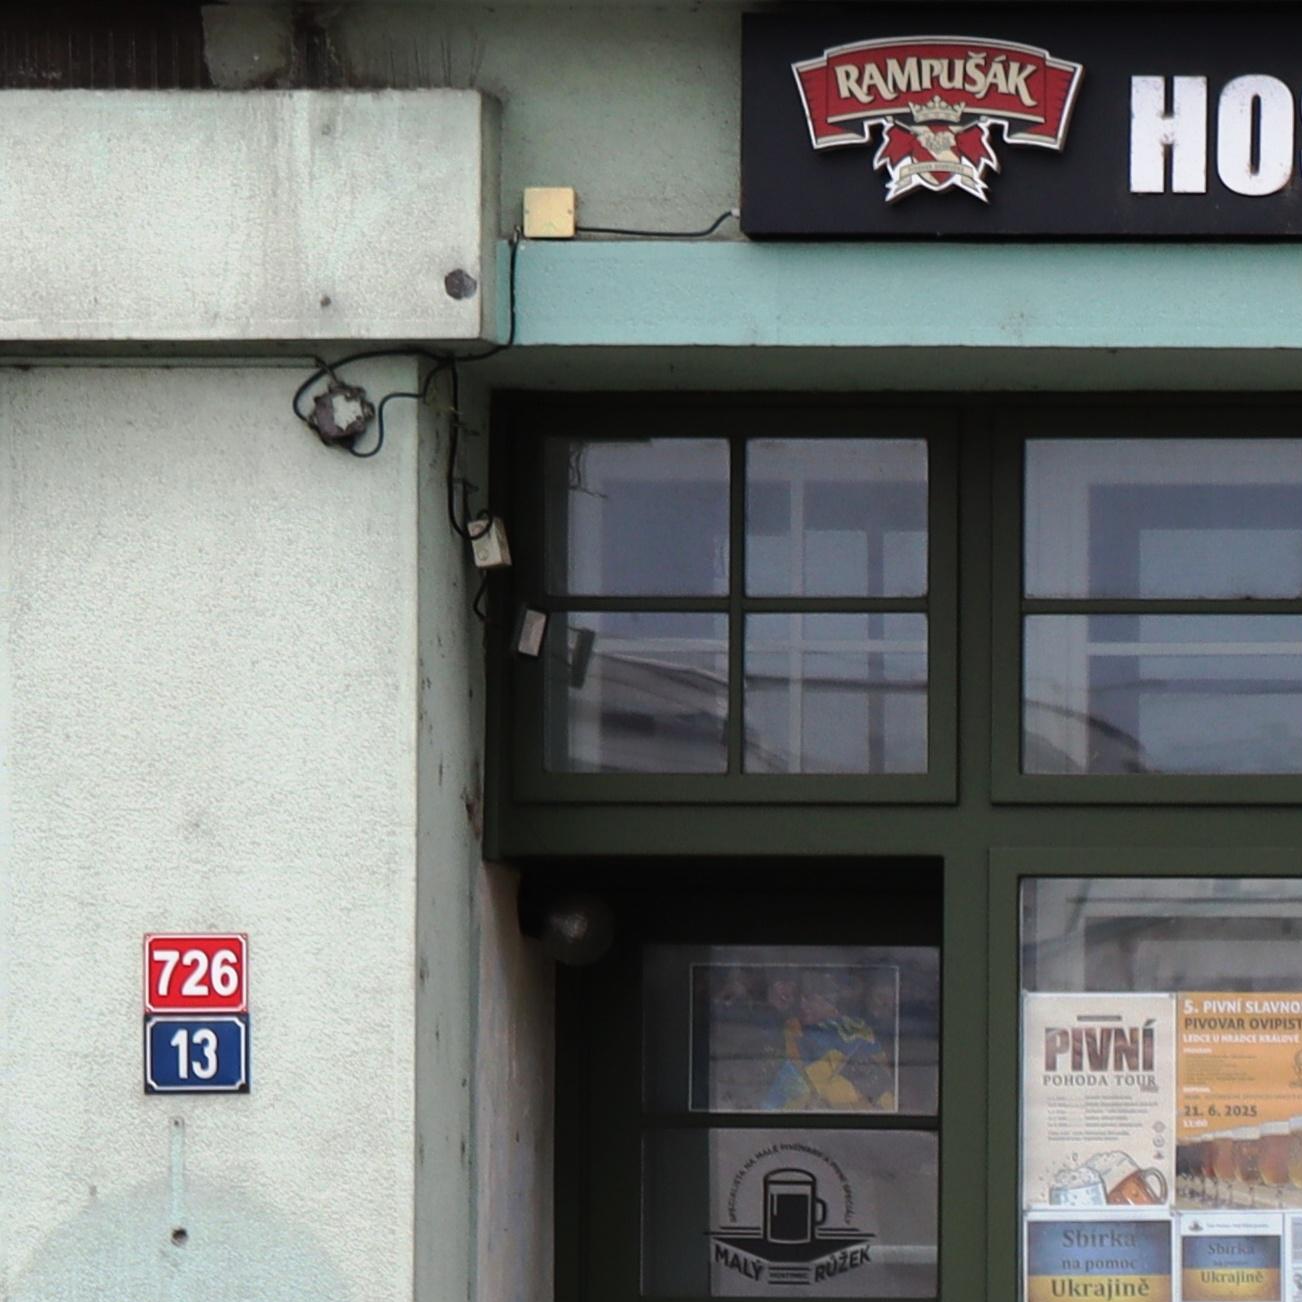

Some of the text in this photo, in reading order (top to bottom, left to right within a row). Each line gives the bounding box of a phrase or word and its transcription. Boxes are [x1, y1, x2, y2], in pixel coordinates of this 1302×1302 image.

[834, 51, 1038, 107] RAMPUŠÁK
[153, 949, 238, 996] 726
[1183, 999, 1199, 1014] 5.
[1204, 998, 1242, 1014] PIVNÍ
[1184, 1018, 1245, 1031] PIVOVAR
[170, 1028, 218, 1079] 13
[1045, 1018, 1157, 1072] PIVNÍ
[1043, 1074, 1157, 1087] POHODA TOUR
[1184, 1104, 1257, 1117] 21. 6. 2025
[1062, 1228, 1137, 1248] Sbírka
[714, 1243, 763, 1282] MALÝ
[815, 1244, 871, 1282] RŮŽEK
[1062, 1259, 1137, 1273] na pomoc
[1200, 1270, 1265, 1286] Ukrajině
[1051, 1278, 1151, 1302] Ukrajině
